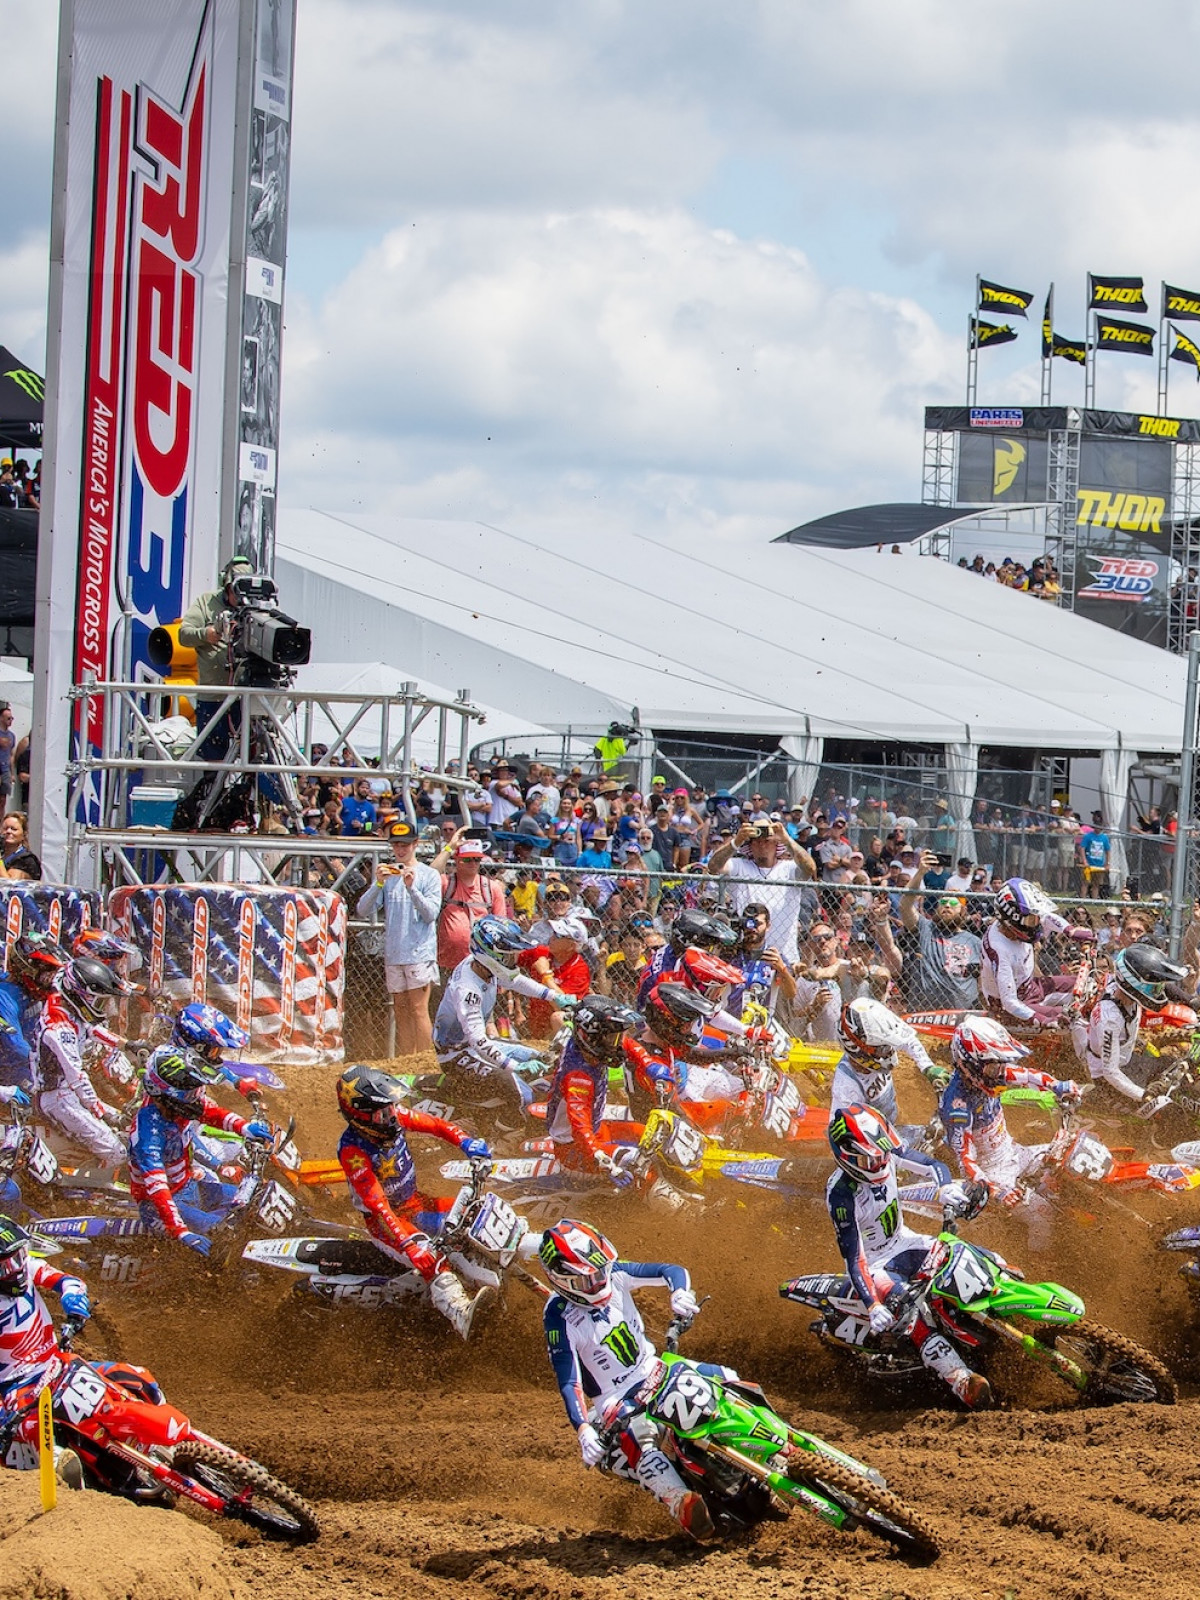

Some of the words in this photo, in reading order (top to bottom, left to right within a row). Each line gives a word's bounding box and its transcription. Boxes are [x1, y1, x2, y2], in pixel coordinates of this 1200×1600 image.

[133, 62, 206, 498] RED
[1101, 325, 1152, 345] THOR
[970, 419, 1023, 427] UNLIMITED
[971, 409, 1023, 420] PARTS
[1138, 416, 1181, 438] THOR
[1075, 489, 1166, 534] THOR
[1095, 555, 1159, 578] RED
[82, 516, 108, 656] MOTOCROSS
[1091, 574, 1153, 594] BUD
[477, 1037, 502, 1060] BAR
[456, 1056, 493, 1077] BAR
[376, 1202, 406, 1240] RACING
[953, 1247, 994, 1304] 47
[835, 1314, 872, 1346] 47
[61, 1365, 107, 1426] 48
[662, 1368, 716, 1431] 29
[43, 1402, 52, 1452] ACERBIS
[6, 1441, 41, 1470] 48
[161, 1475, 210, 1504] DUNLOP
[790, 1485, 838, 1518] DUNLOP
